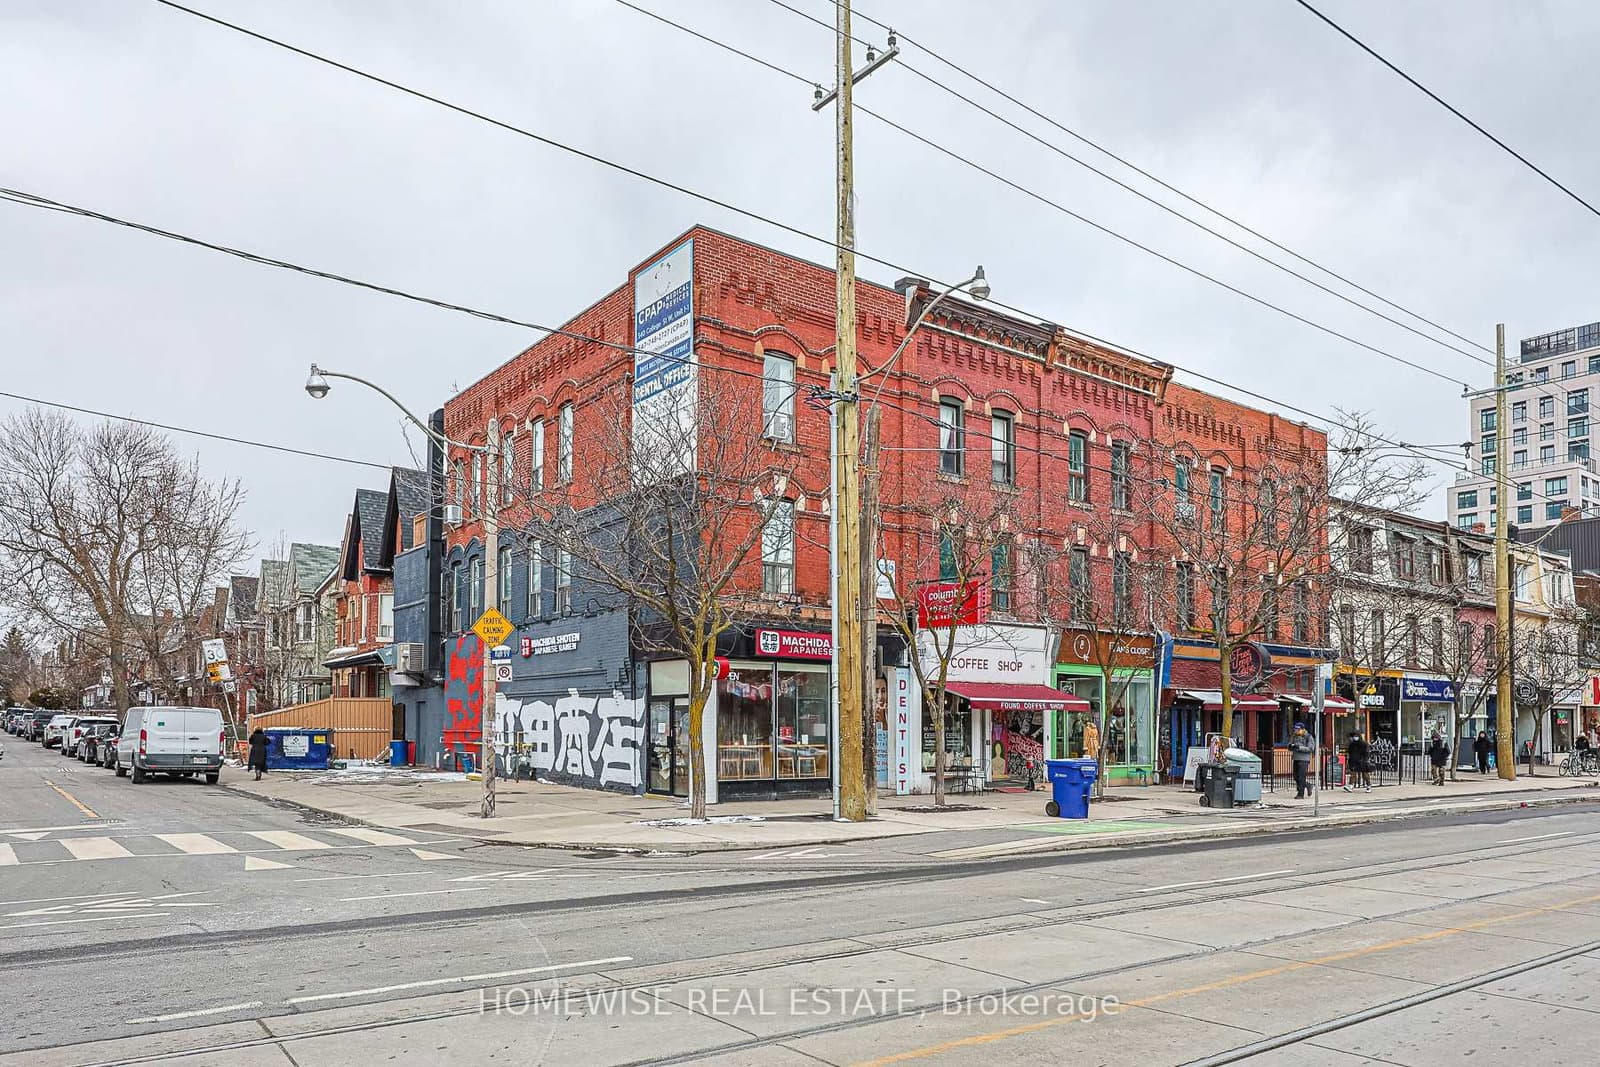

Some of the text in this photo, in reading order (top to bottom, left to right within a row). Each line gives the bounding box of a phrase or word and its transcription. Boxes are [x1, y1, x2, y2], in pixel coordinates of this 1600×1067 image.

[666, 284, 689, 302] MEDICAL
[666, 291, 689, 309] DEVICES
[638, 301, 662, 324] CPAP
[664, 365, 690, 386] OFFICE
[483, 617, 503, 625] TRAFFIC
[483, 626, 504, 635] CALMING
[488, 635, 500, 643] ZONE
[557, 632, 580, 644] SHOTEN
[782, 636, 831, 648] MACHIDA
[207, 649, 224, 661] 30
[950, 657, 1023, 672] COFFEE SHOP
[1000, 702, 1020, 710] FOUND
[1023, 702, 1047, 710] COFFEE
[898, 679, 907, 792] DENTIST
